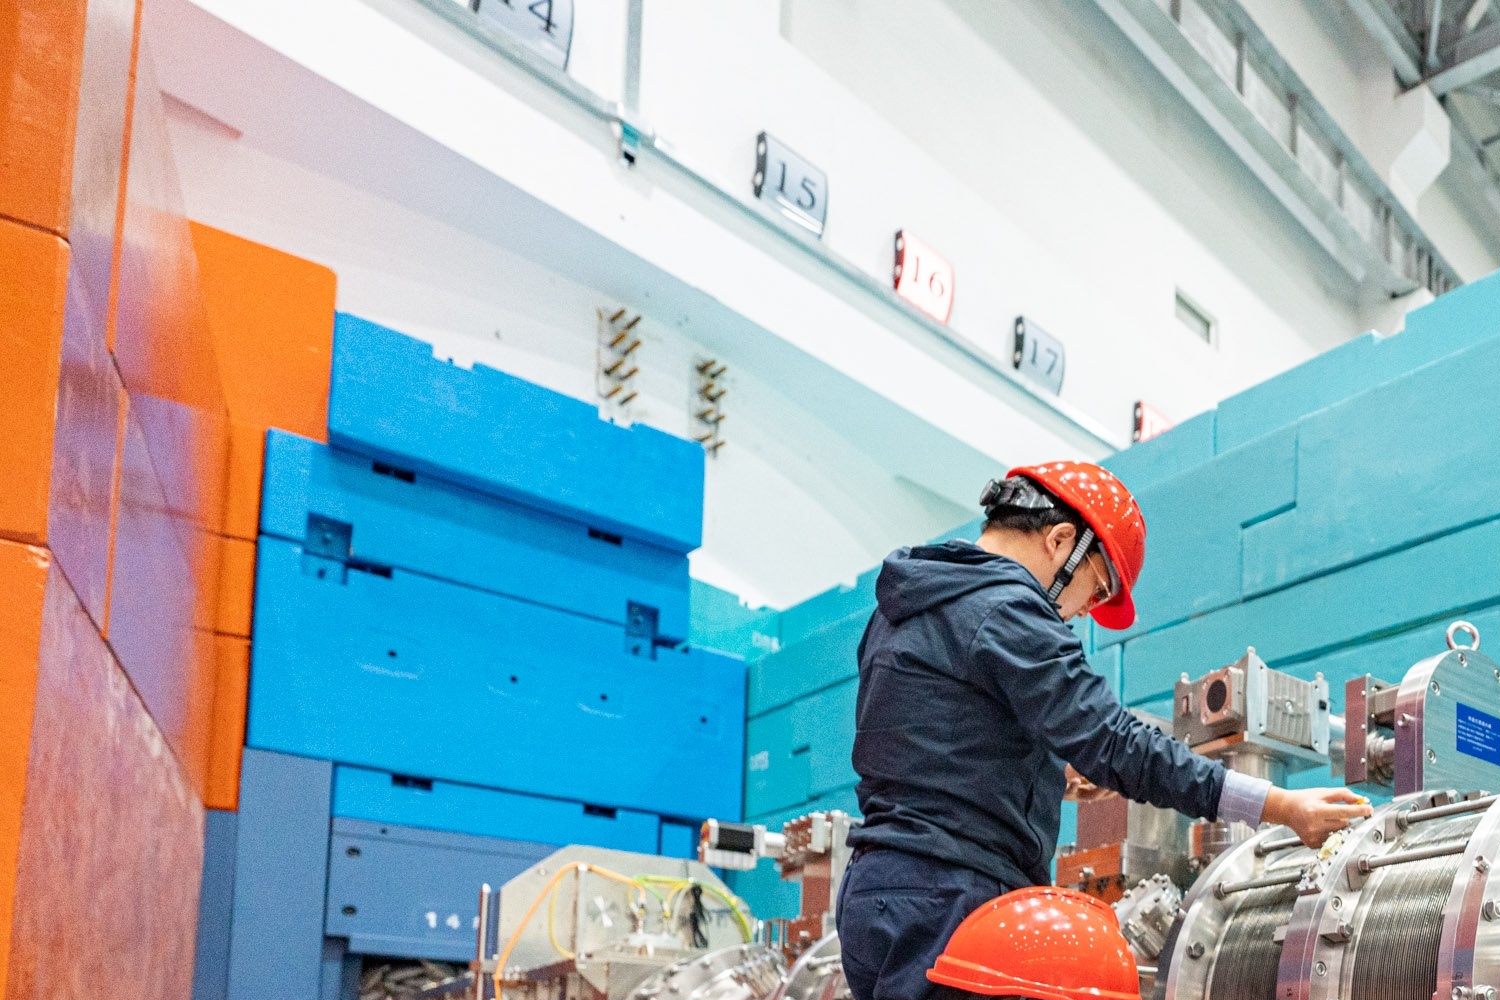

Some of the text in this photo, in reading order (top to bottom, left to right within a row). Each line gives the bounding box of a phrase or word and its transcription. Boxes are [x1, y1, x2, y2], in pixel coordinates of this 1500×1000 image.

[501, 0, 557, 37] 4
[778, 161, 816, 210] 15
[914, 256, 945, 297] 16
[1031, 338, 1058, 375] 17
